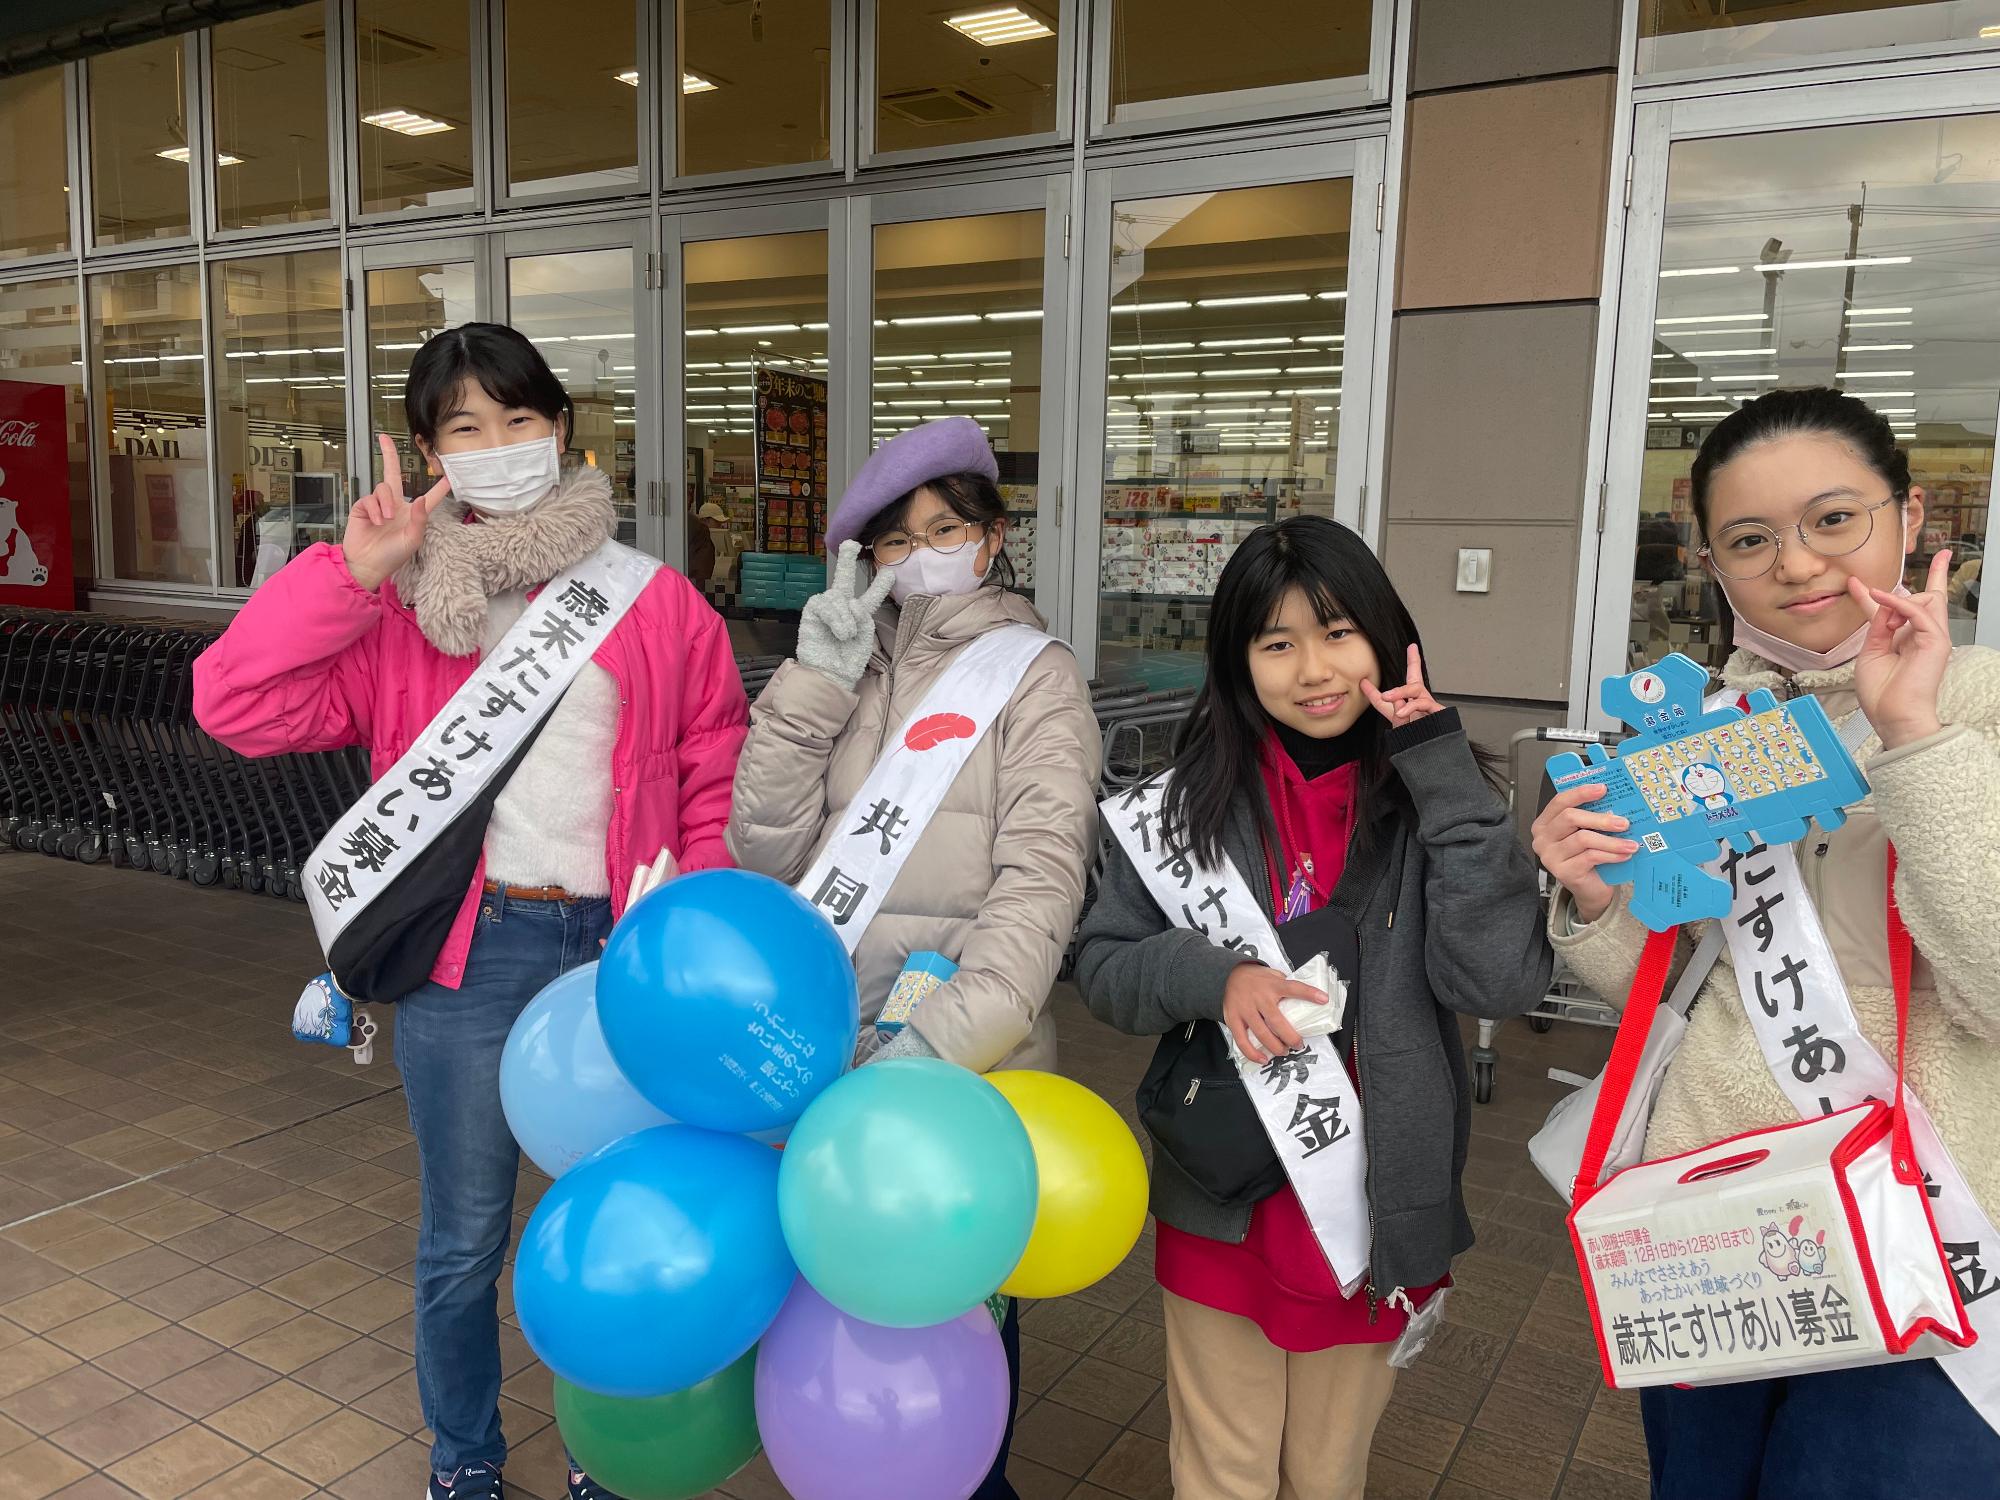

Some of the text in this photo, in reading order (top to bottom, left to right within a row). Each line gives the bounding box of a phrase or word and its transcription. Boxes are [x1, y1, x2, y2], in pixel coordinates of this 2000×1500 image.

[1686, 431, 1695, 444] 9
[280, 457, 289, 468] 6
[407, 458, 415, 469] 5
[313, 578, 611, 912] 歳末たすけあい募金
[811, 797, 910, 925] 共同
[753, 999, 815, 1057] うれしいな
[748, 1021, 813, 1084] ちいきの人の
[1586, 1227, 1651, 1254] 赤い羽根共同募金
[1610, 1258, 1711, 1290] みんなでささえあう
[1640, 1270, 1763, 1305] あったかい地域づくり
[1612, 1284, 1860, 1367] 歳末たすけあい募金
